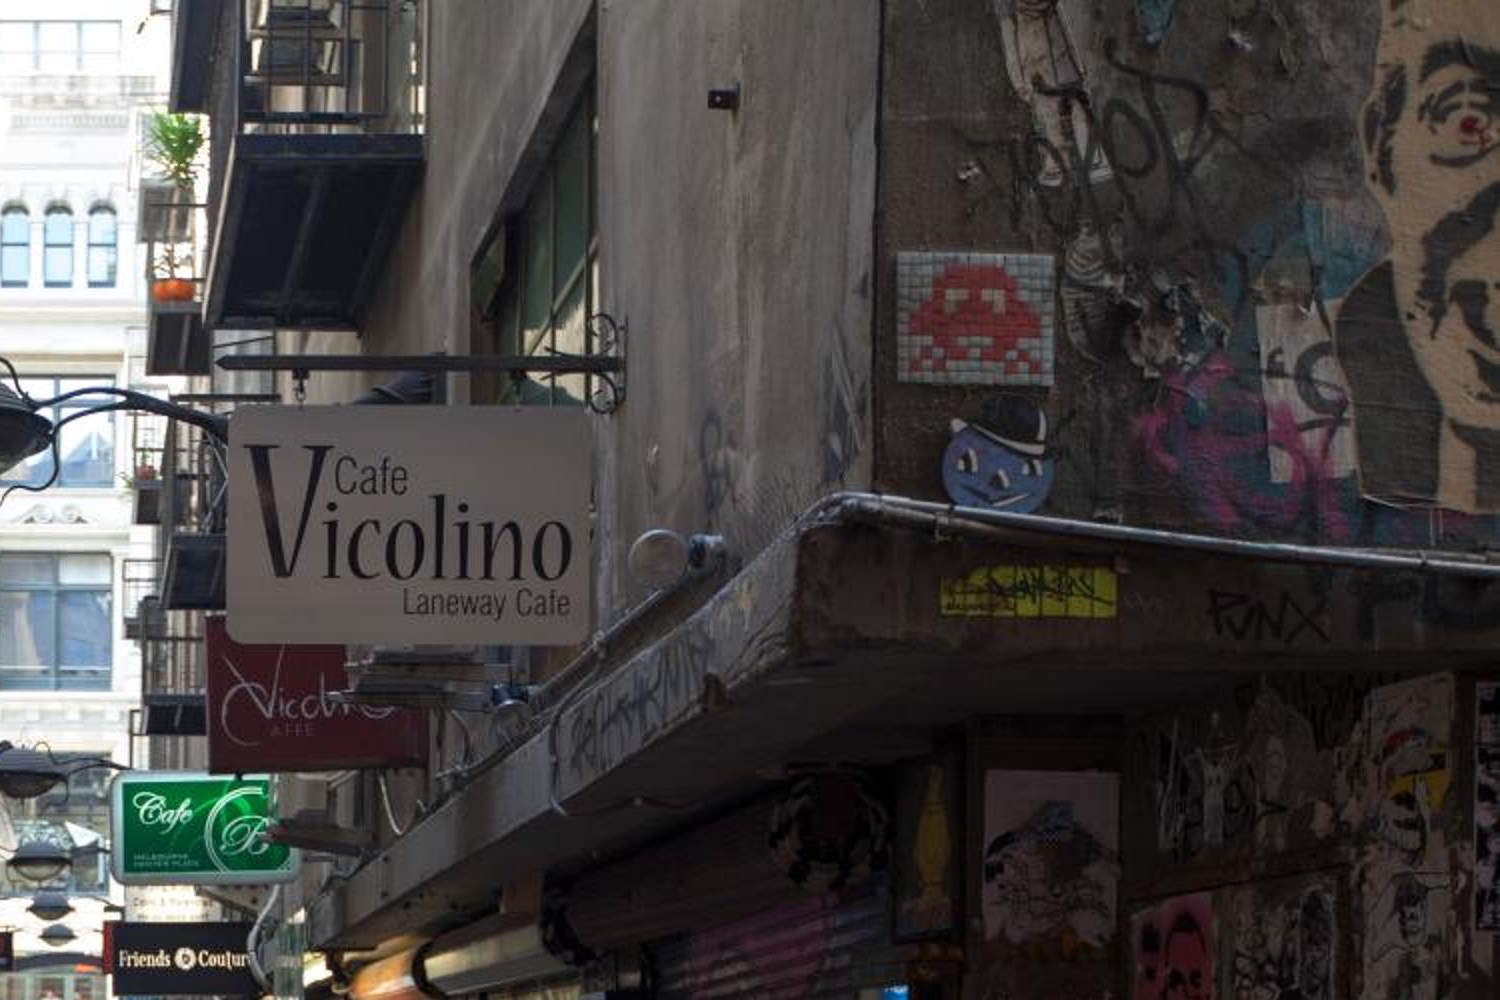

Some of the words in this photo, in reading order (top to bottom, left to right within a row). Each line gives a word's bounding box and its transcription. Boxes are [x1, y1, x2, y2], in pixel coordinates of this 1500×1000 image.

[334, 455, 409, 496] Cafe
[243, 443, 573, 582] Vicolino
[403, 588, 507, 620] Laneway
[516, 587, 571, 617] Cafe
[133, 790, 194, 835] Cafe
[119, 949, 171, 968] Friends
[197, 949, 251, 969] Coutur
